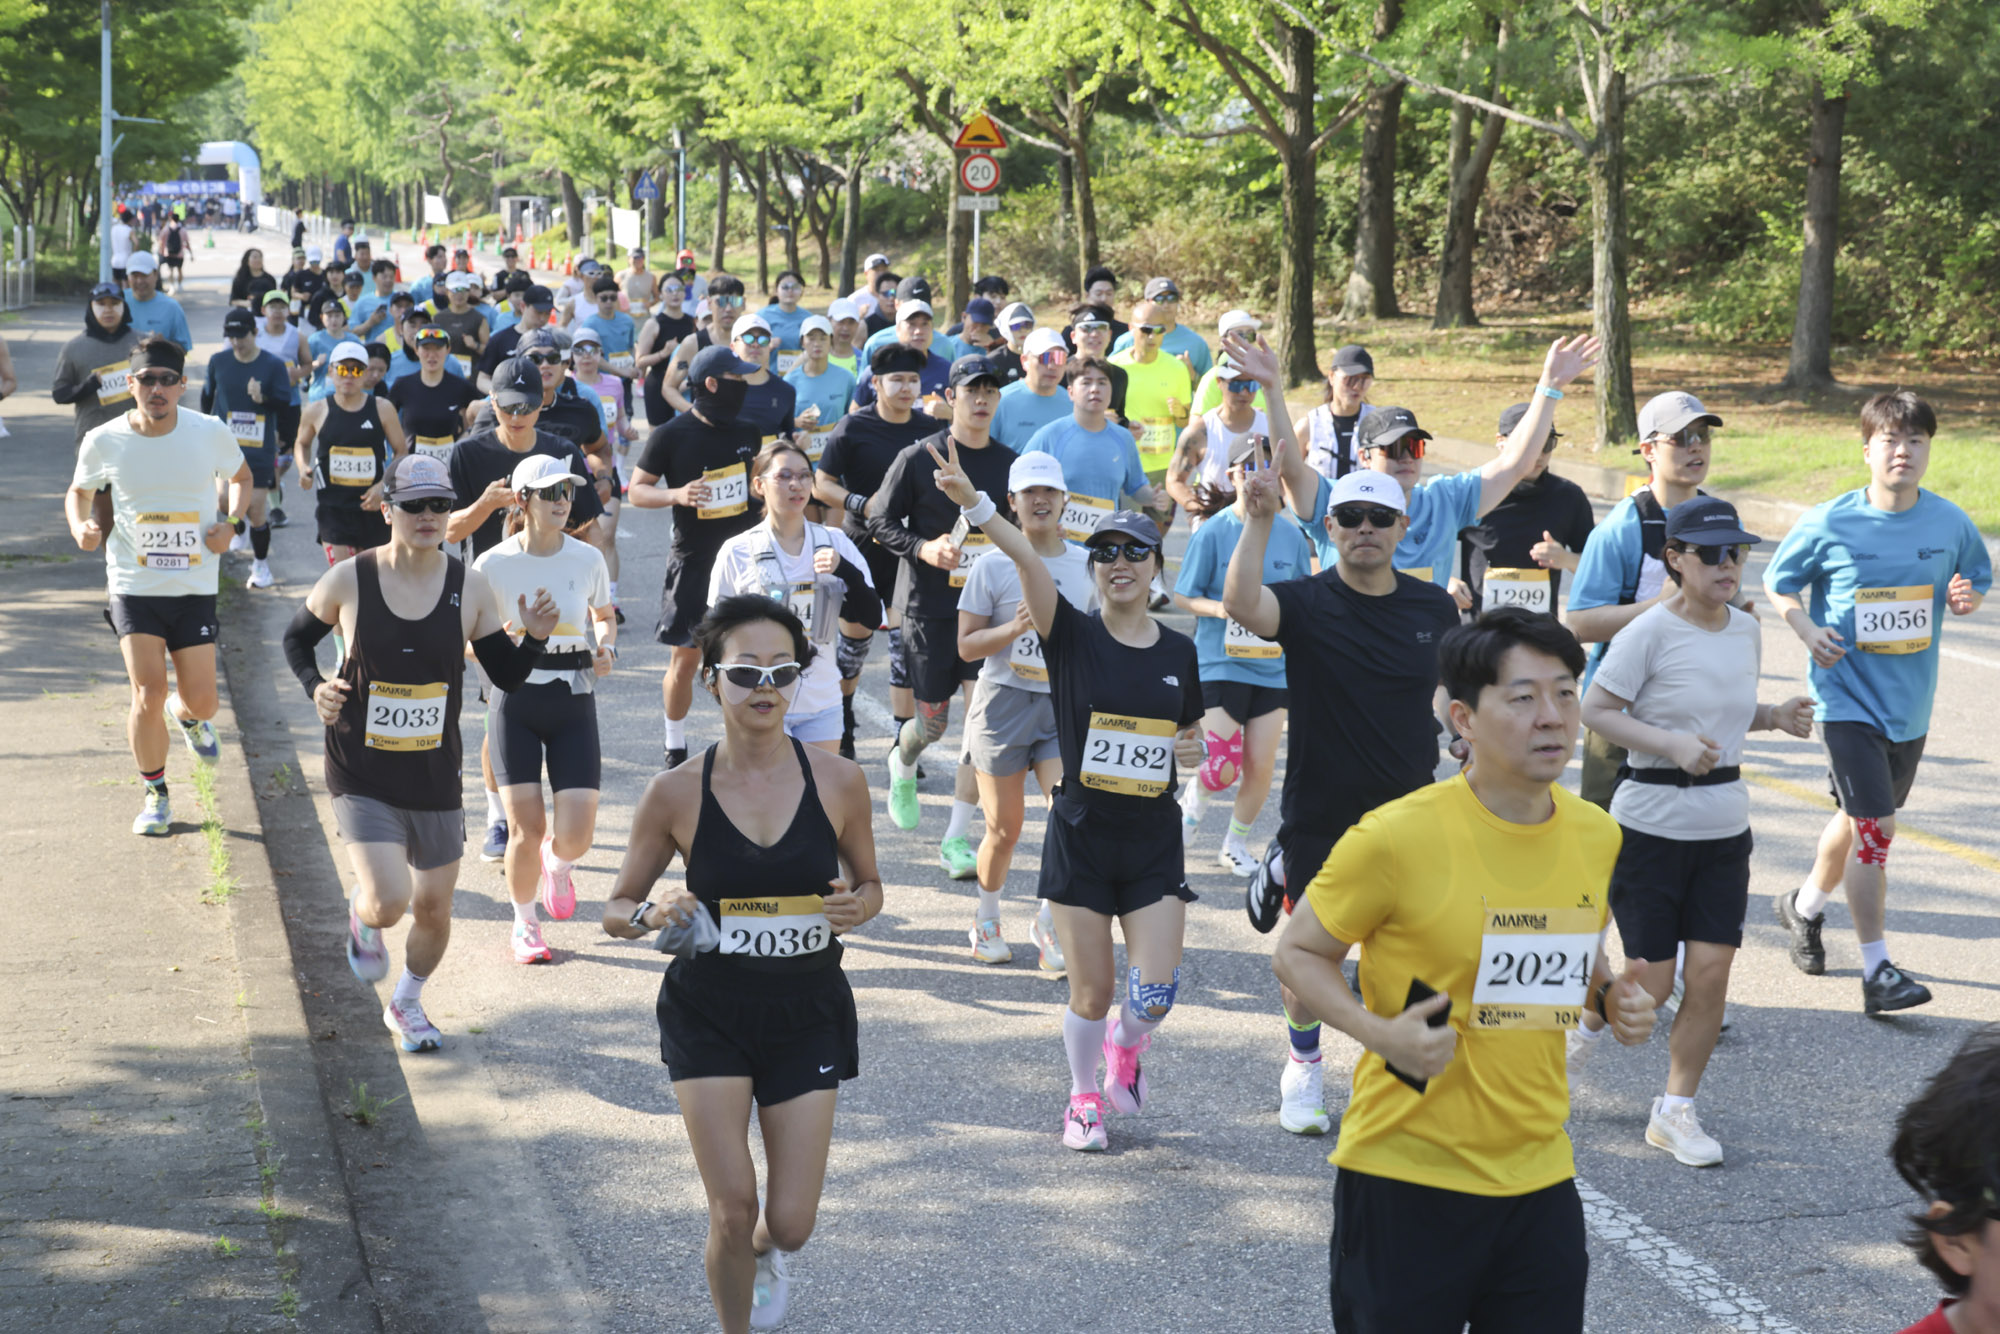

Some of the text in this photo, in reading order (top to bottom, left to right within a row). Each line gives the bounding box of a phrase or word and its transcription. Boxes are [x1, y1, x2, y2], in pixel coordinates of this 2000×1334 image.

[970, 165, 991, 181] 20
[333, 460, 372, 473] 2343
[716, 480, 743, 501] 127
[1065, 508, 1100, 527] 307
[141, 530, 197, 548] 2245
[155, 558, 182, 567] 0281
[1491, 588, 1545, 606] 1299
[1863, 608, 1927, 633] 3056
[373, 705, 441, 729] 2033
[1090, 739, 1167, 770] 2182
[1136, 783, 1164, 793] 10 km
[727, 901, 779, 915] 시사저널
[1491, 913, 1547, 930] 시사저널
[730, 925, 823, 957] 2036
[1487, 950, 1591, 987] 2024
[1554, 1011, 1571, 1025] 10
